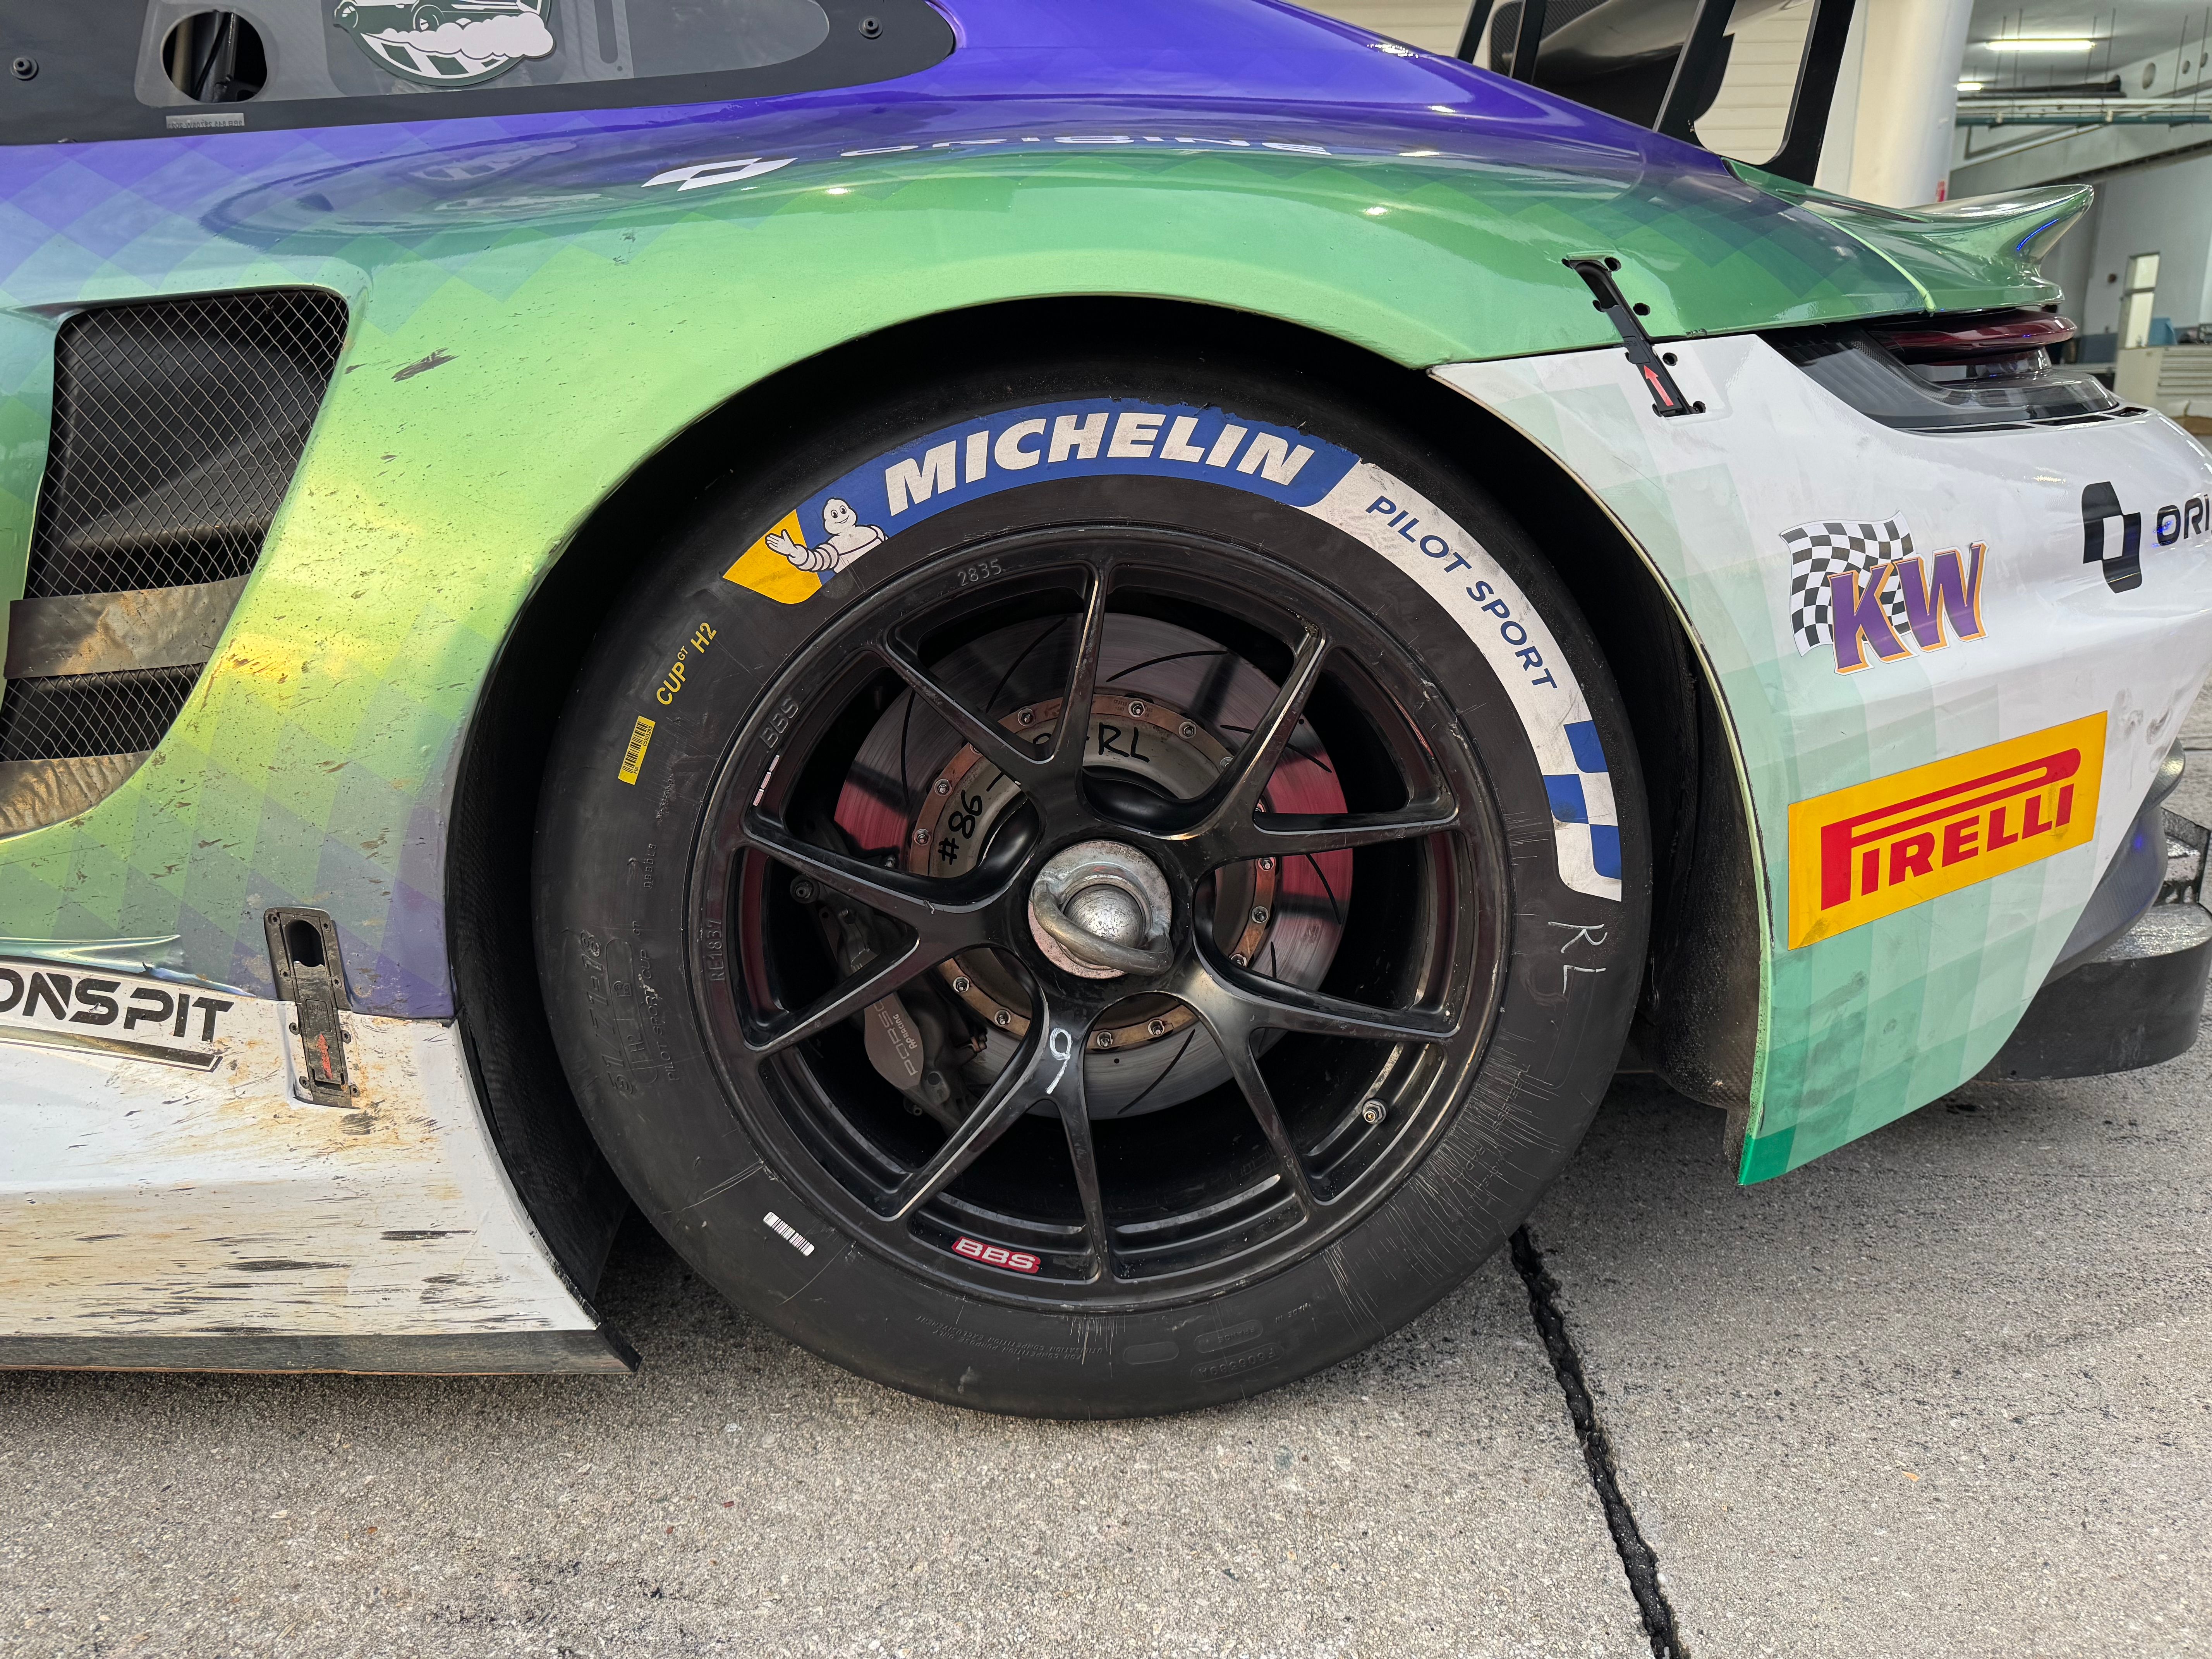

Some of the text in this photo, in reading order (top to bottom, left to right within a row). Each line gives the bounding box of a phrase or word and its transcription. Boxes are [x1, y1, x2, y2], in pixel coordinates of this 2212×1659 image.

[884, 412, 1315, 517] MICHELIN
[2156, 494, 2212, 546] ORI
[957, 558, 1002, 586] 2835
[1365, 495, 1559, 689] PILOT SPORT
[1827, 543, 1988, 675] KW
[656, 661, 686, 705] CUP
[690, 622, 717, 654] H2
[760, 695, 799, 749] BBS
[1820, 747, 2081, 910] PIRELLI
[641, 949, 651, 979] CUP
[706, 918, 726, 981] RE1837
[1548, 921, 1608, 995] RL
[657, 1041, 680, 1080] PILOT
[1045, 1027, 1072, 1094] 9
[955, 1238, 1036, 1269] BBS
[915, 1316, 984, 1341] EXCLUSIVEMENT
[932, 1329, 955, 1340] ONLY
[959, 1336, 1000, 1351] PURPOSE
[987, 1336, 1044, 1351] COMPETITION
[1002, 1346, 1060, 1359] COMPETITION
